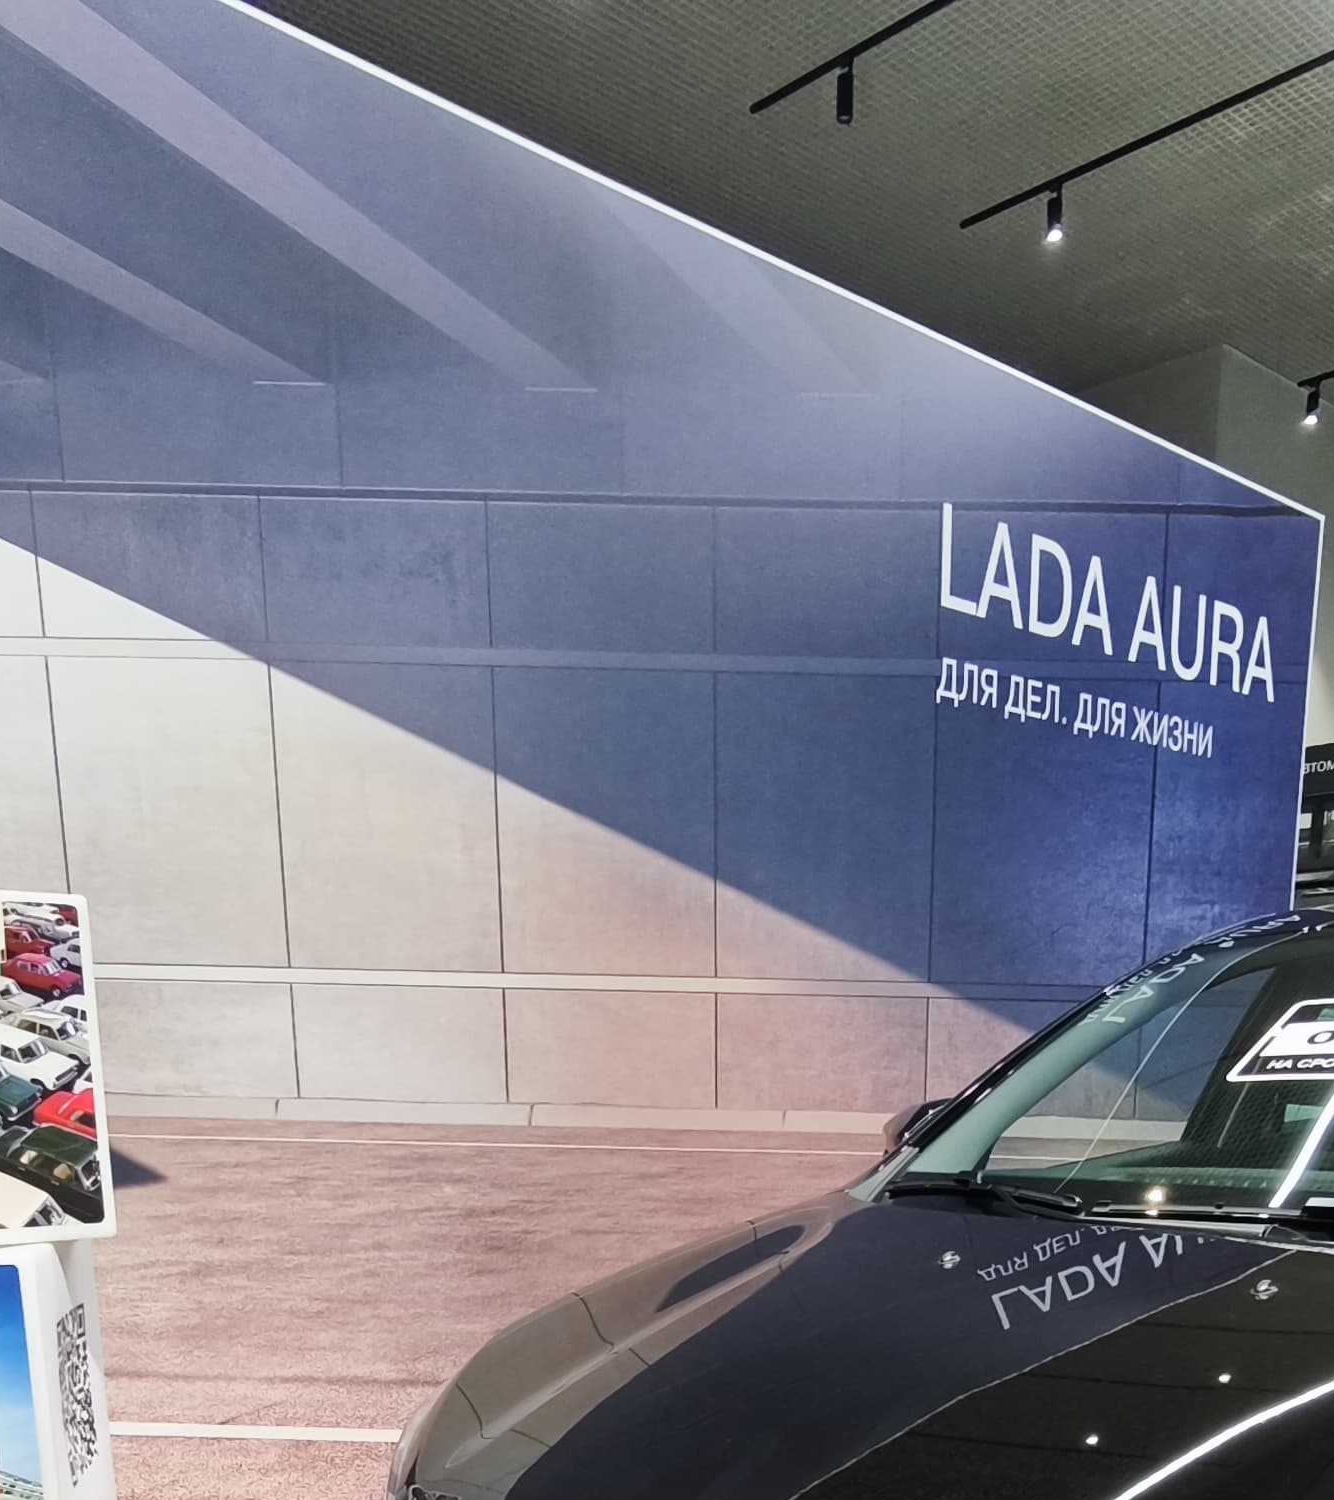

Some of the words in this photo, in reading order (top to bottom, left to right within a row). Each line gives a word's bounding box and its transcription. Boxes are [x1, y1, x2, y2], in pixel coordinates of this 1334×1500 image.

[940, 502, 1113, 655] LADA
[1128, 575, 1275, 703] AURA
[936, 656, 998, 708] ДЛЯ
[1004, 674, 1067, 723] ДЕЛ.
[1073, 692, 1127, 739] ДЛЯ
[1130, 706, 1214, 759] ЖИЗНИ
[1265, 1057, 1293, 1071] НА
